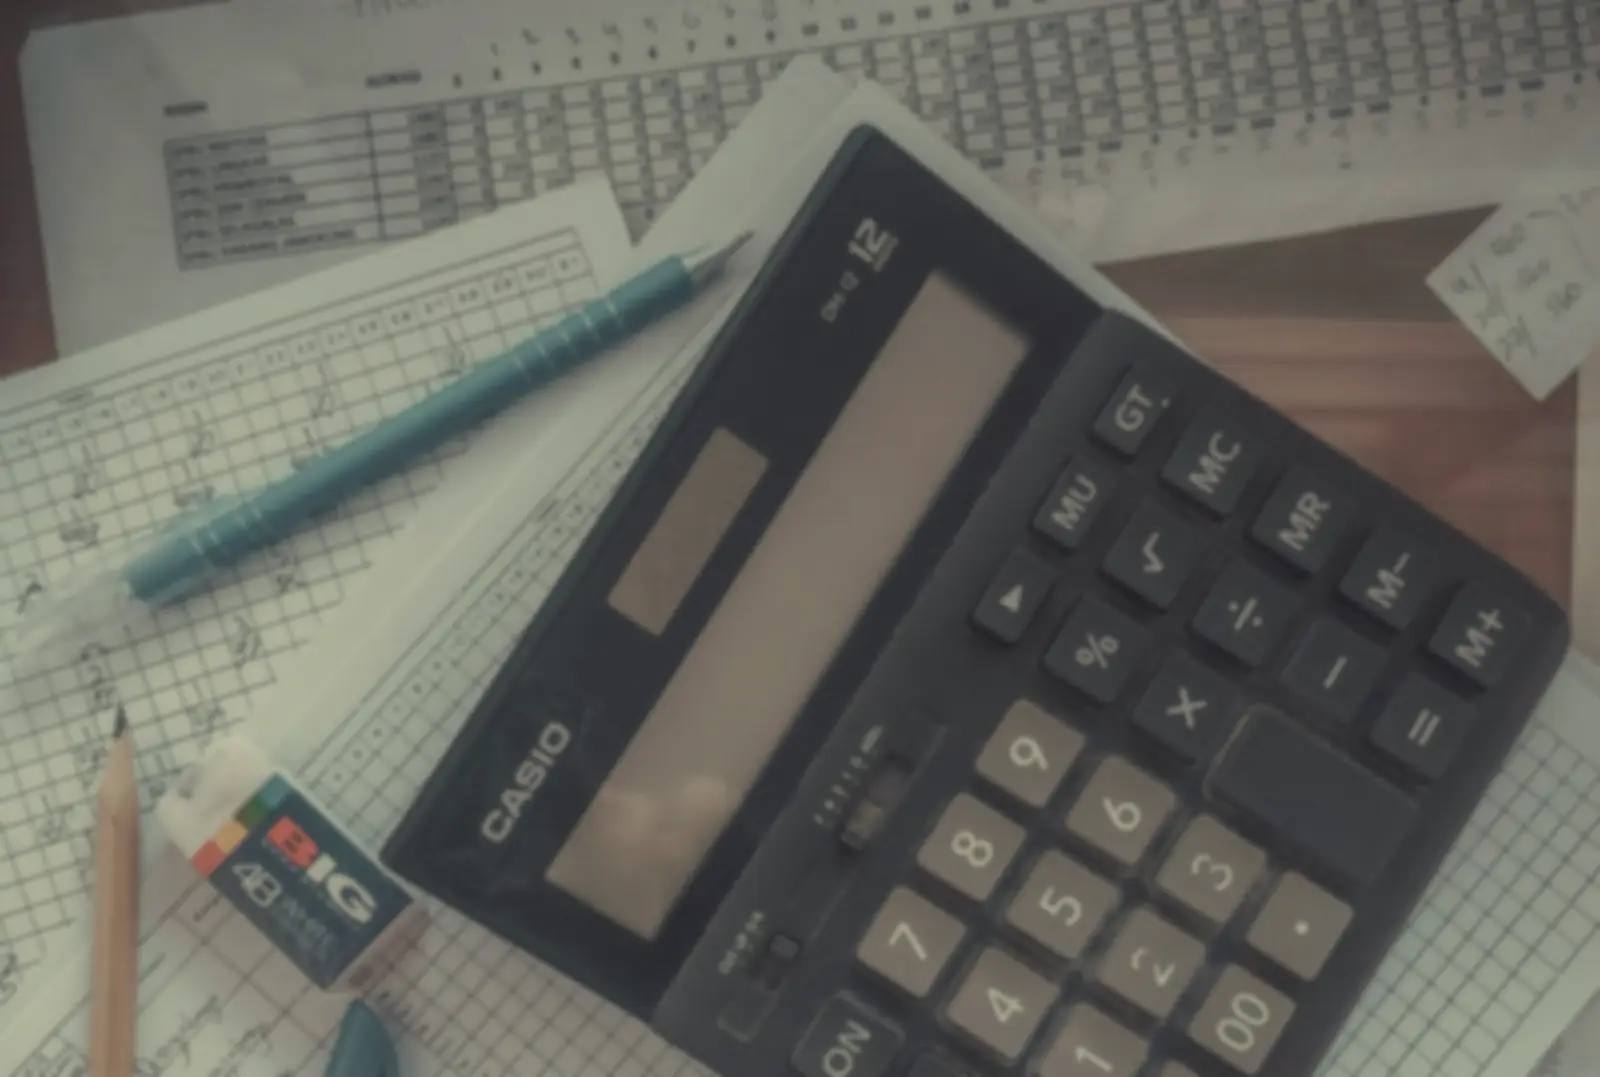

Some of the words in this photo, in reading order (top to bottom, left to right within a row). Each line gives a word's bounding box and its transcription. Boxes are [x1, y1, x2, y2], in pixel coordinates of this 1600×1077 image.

[847, 214, 892, 263] 12
[1187, 431, 1241, 495] MC
[1050, 474, 1098, 532] MU
[1278, 490, 1330, 552] MR
[1073, 632, 1121, 671] %
[1453, 608, 1504, 669] M+
[1007, 735, 1050, 772] 9
[480, 721, 572, 842] CASIO
[1101, 796, 1143, 833] 6
[266, 815, 376, 924] BIG
[949, 829, 995, 868] 8
[1189, 851, 1236, 894] 3
[1037, 886, 1084, 928] 5
[887, 920, 930, 962] 7
[1128, 945, 1177, 988] 2
[985, 985, 1026, 1025] 4
[1213, 990, 1273, 1054] 00
[822, 1017, 873, 1077] ON
[1074, 1045, 1116, 1074] 1
